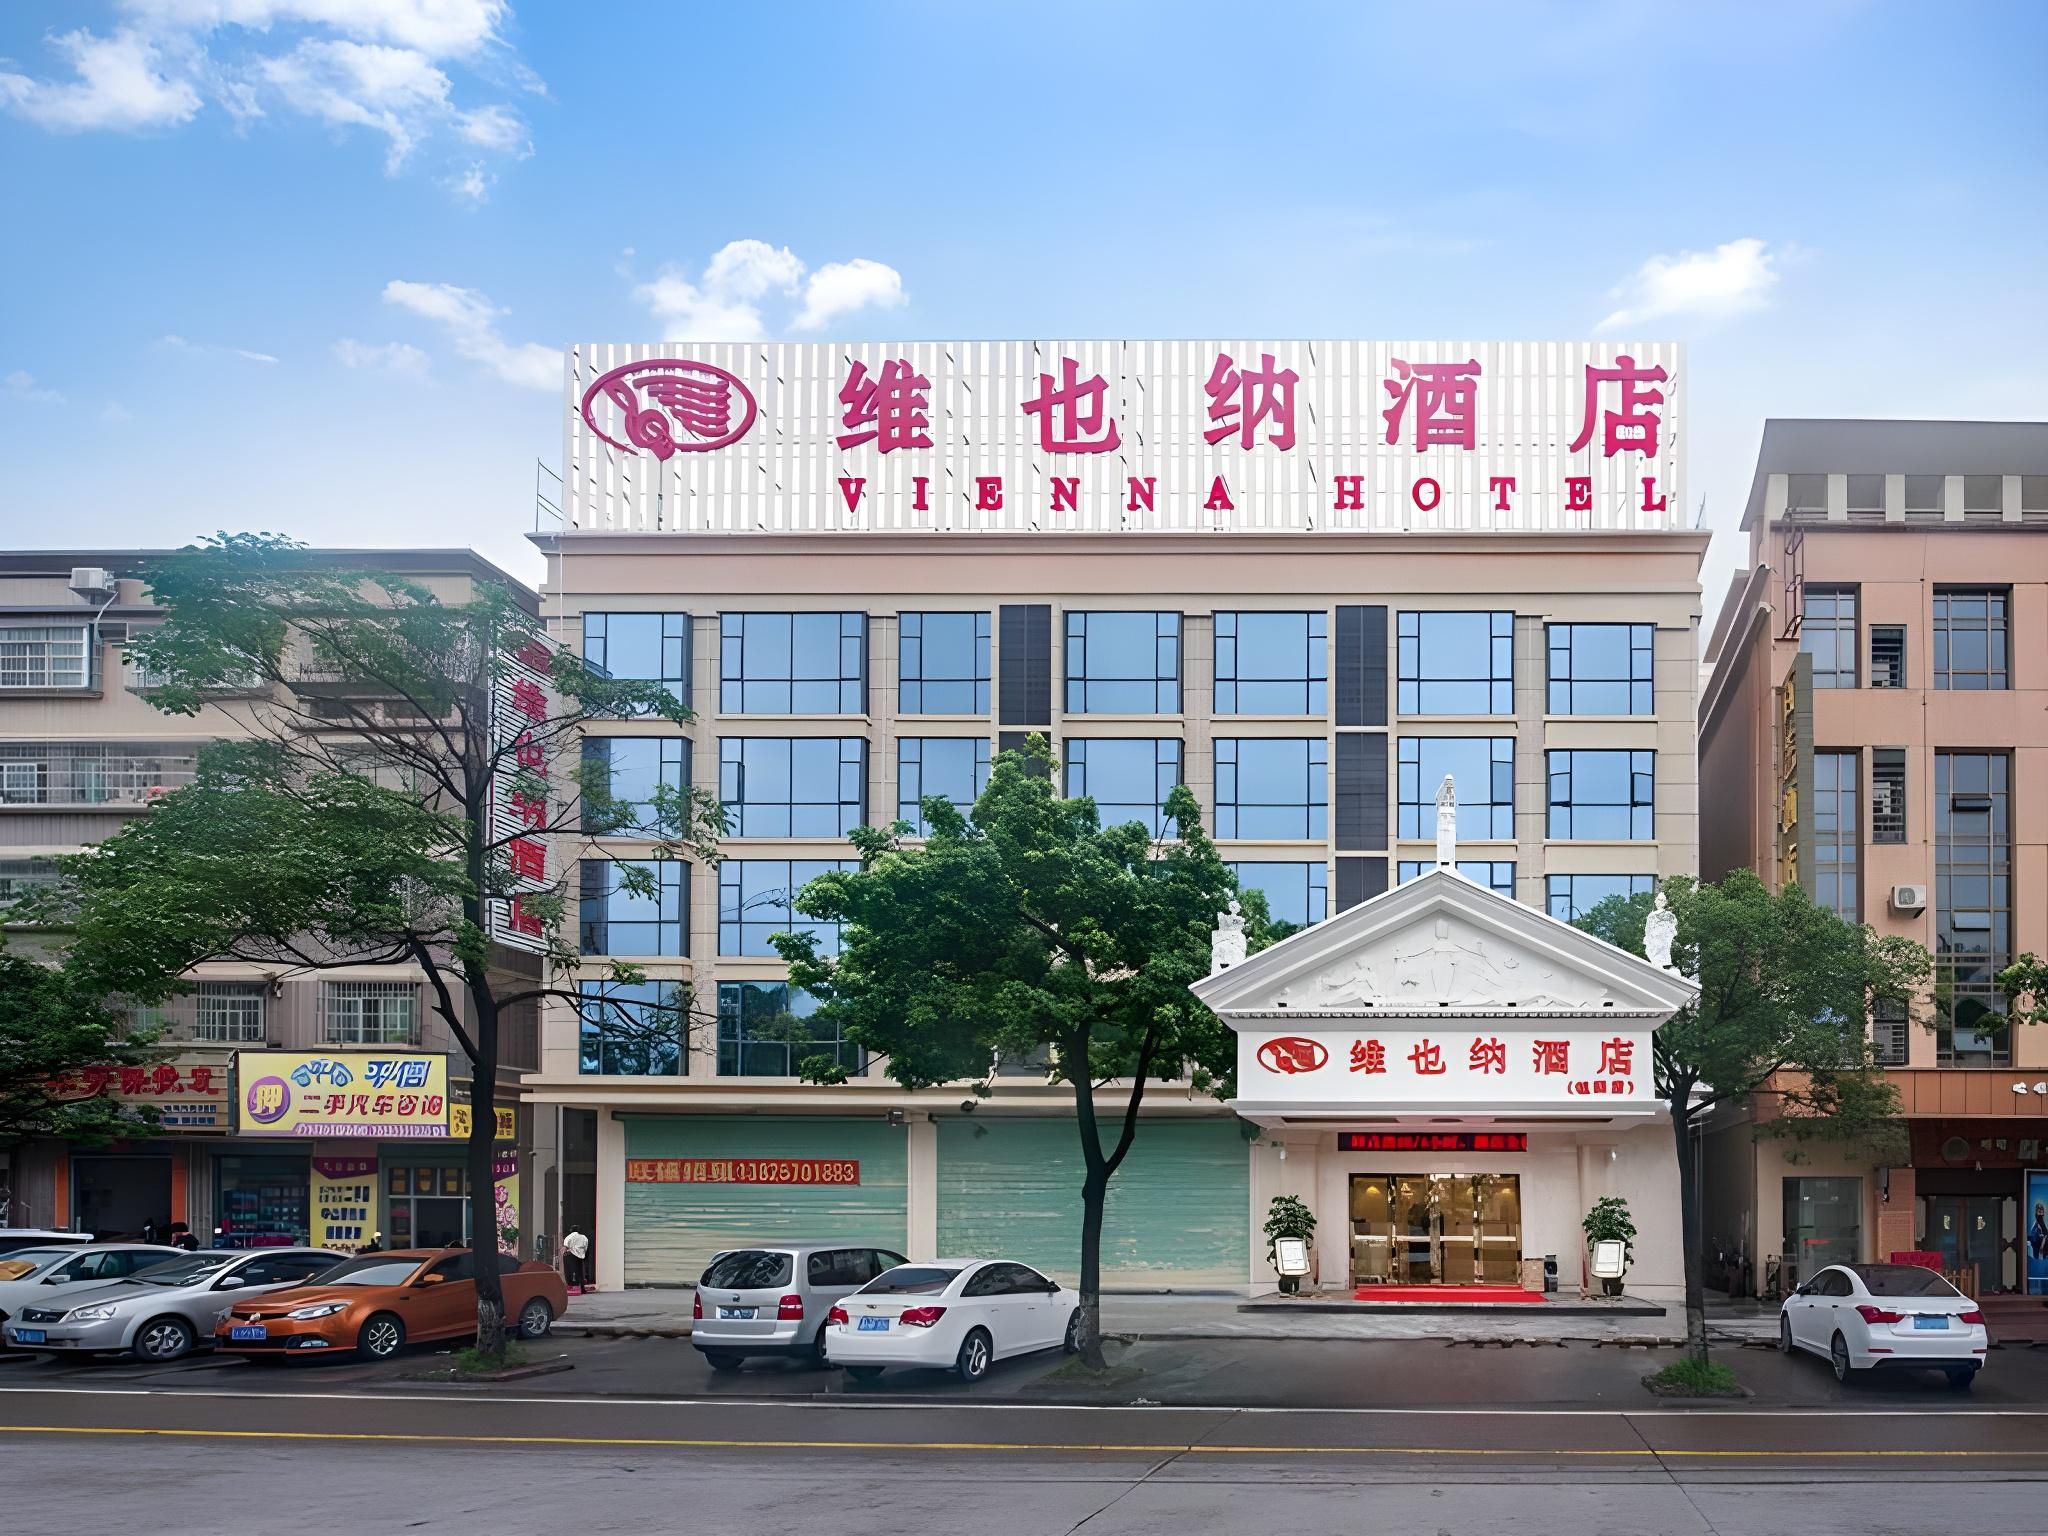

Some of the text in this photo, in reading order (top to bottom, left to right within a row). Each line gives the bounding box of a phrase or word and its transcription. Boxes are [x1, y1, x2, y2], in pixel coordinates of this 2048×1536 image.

[836, 353, 1669, 459] 维也纳酒店
[838, 475, 1667, 513] VIENNA HOTEL
[1349, 1036, 1634, 1076] 维也纳酒店
